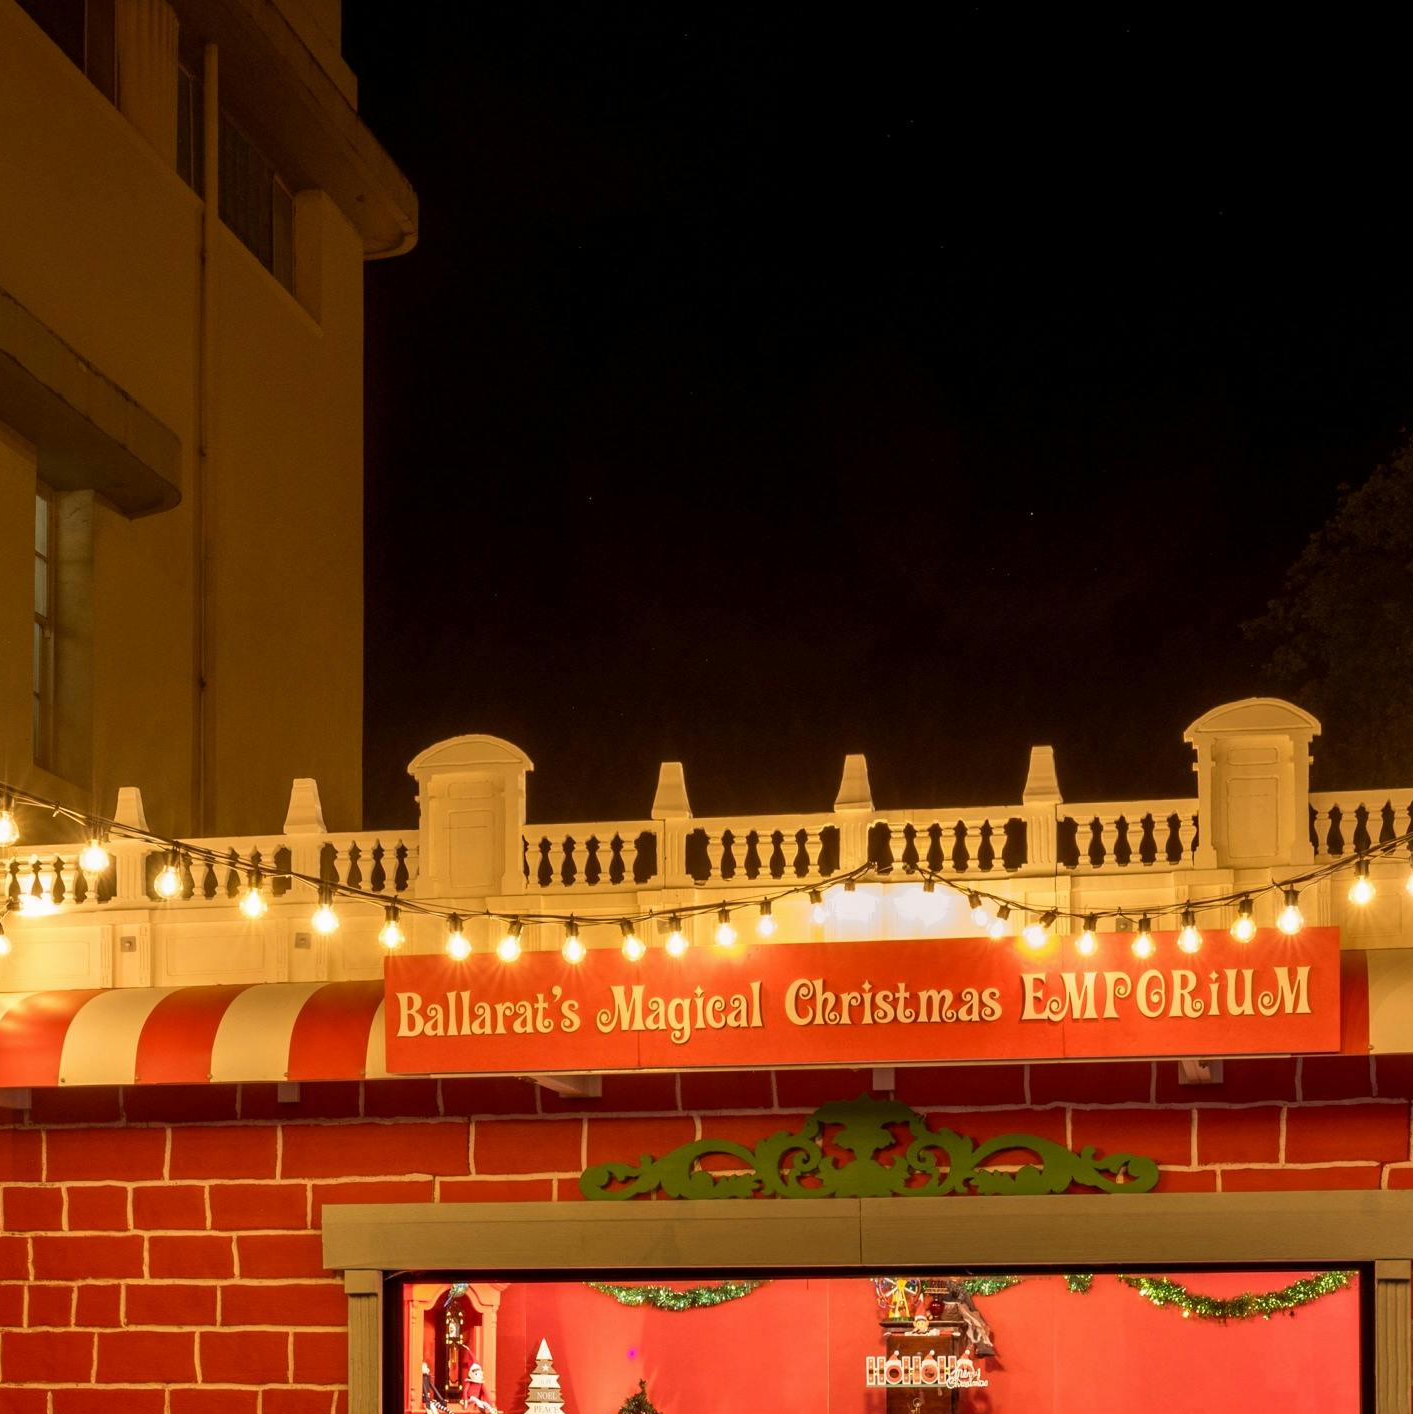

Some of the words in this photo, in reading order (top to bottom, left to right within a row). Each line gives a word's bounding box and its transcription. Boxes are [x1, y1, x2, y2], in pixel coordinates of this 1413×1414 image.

[395, 985, 581, 1038] Ballarat's
[596, 980, 764, 1044] Magical
[784, 978, 1003, 1026] Christmas
[537, 1391, 556, 1400] NOEL
[534, 1405, 560, 1414] PEACE
